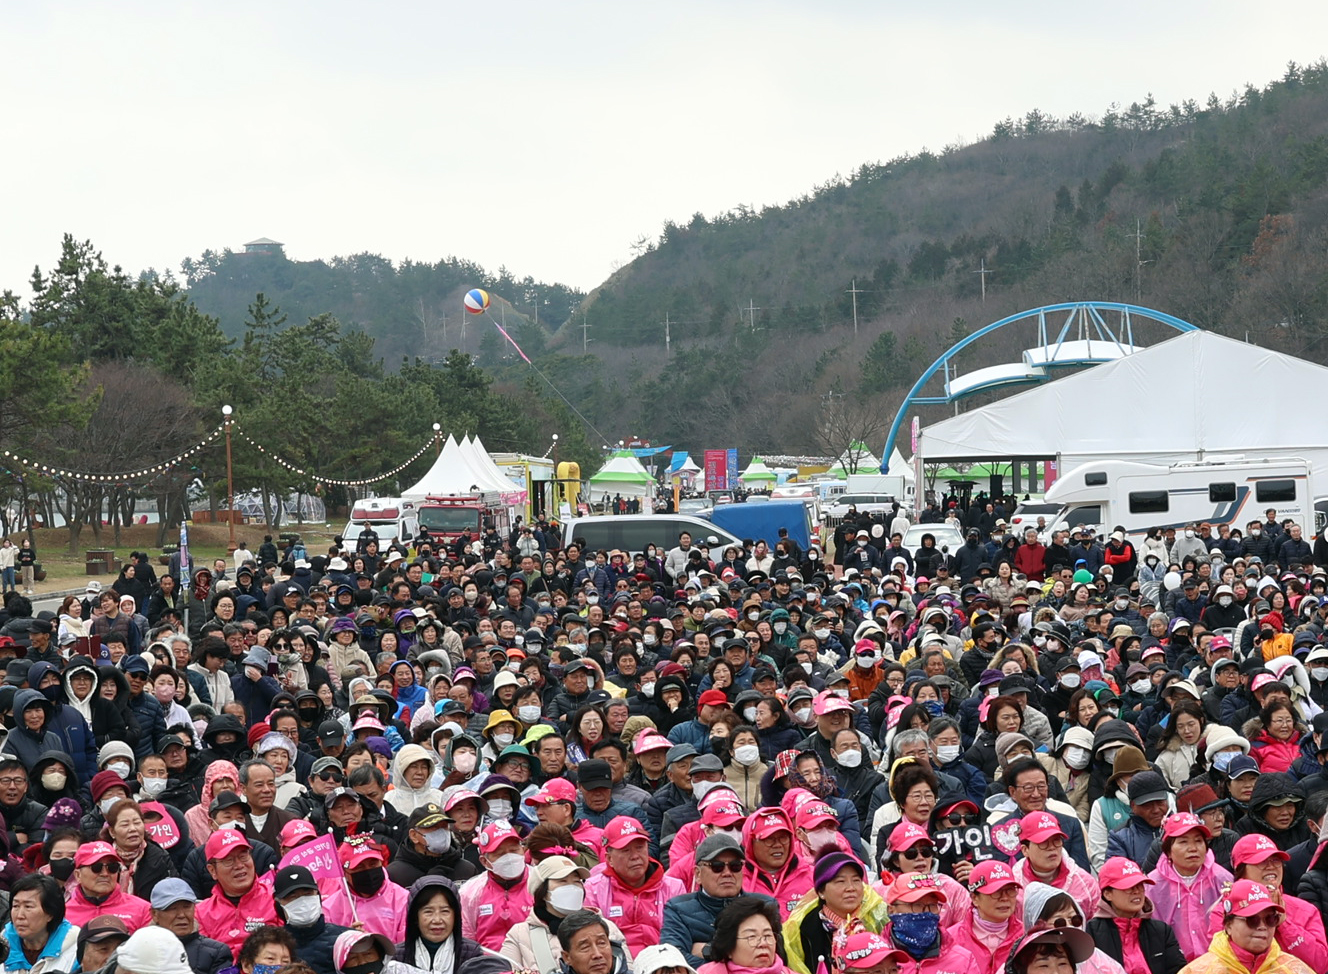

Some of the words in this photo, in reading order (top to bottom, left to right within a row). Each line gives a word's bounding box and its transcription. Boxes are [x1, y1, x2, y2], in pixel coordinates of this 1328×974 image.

[764, 817, 783, 827] Again
[1038, 820, 1056, 829] Again
[150, 824, 174, 836] 가인
[293, 826, 311, 834] Again
[221, 836, 240, 846] Again
[933, 825, 992, 861] 가인
[93, 845, 113, 854] Again
[989, 870, 1010, 879] Again
[1248, 892, 1269, 902] Again
